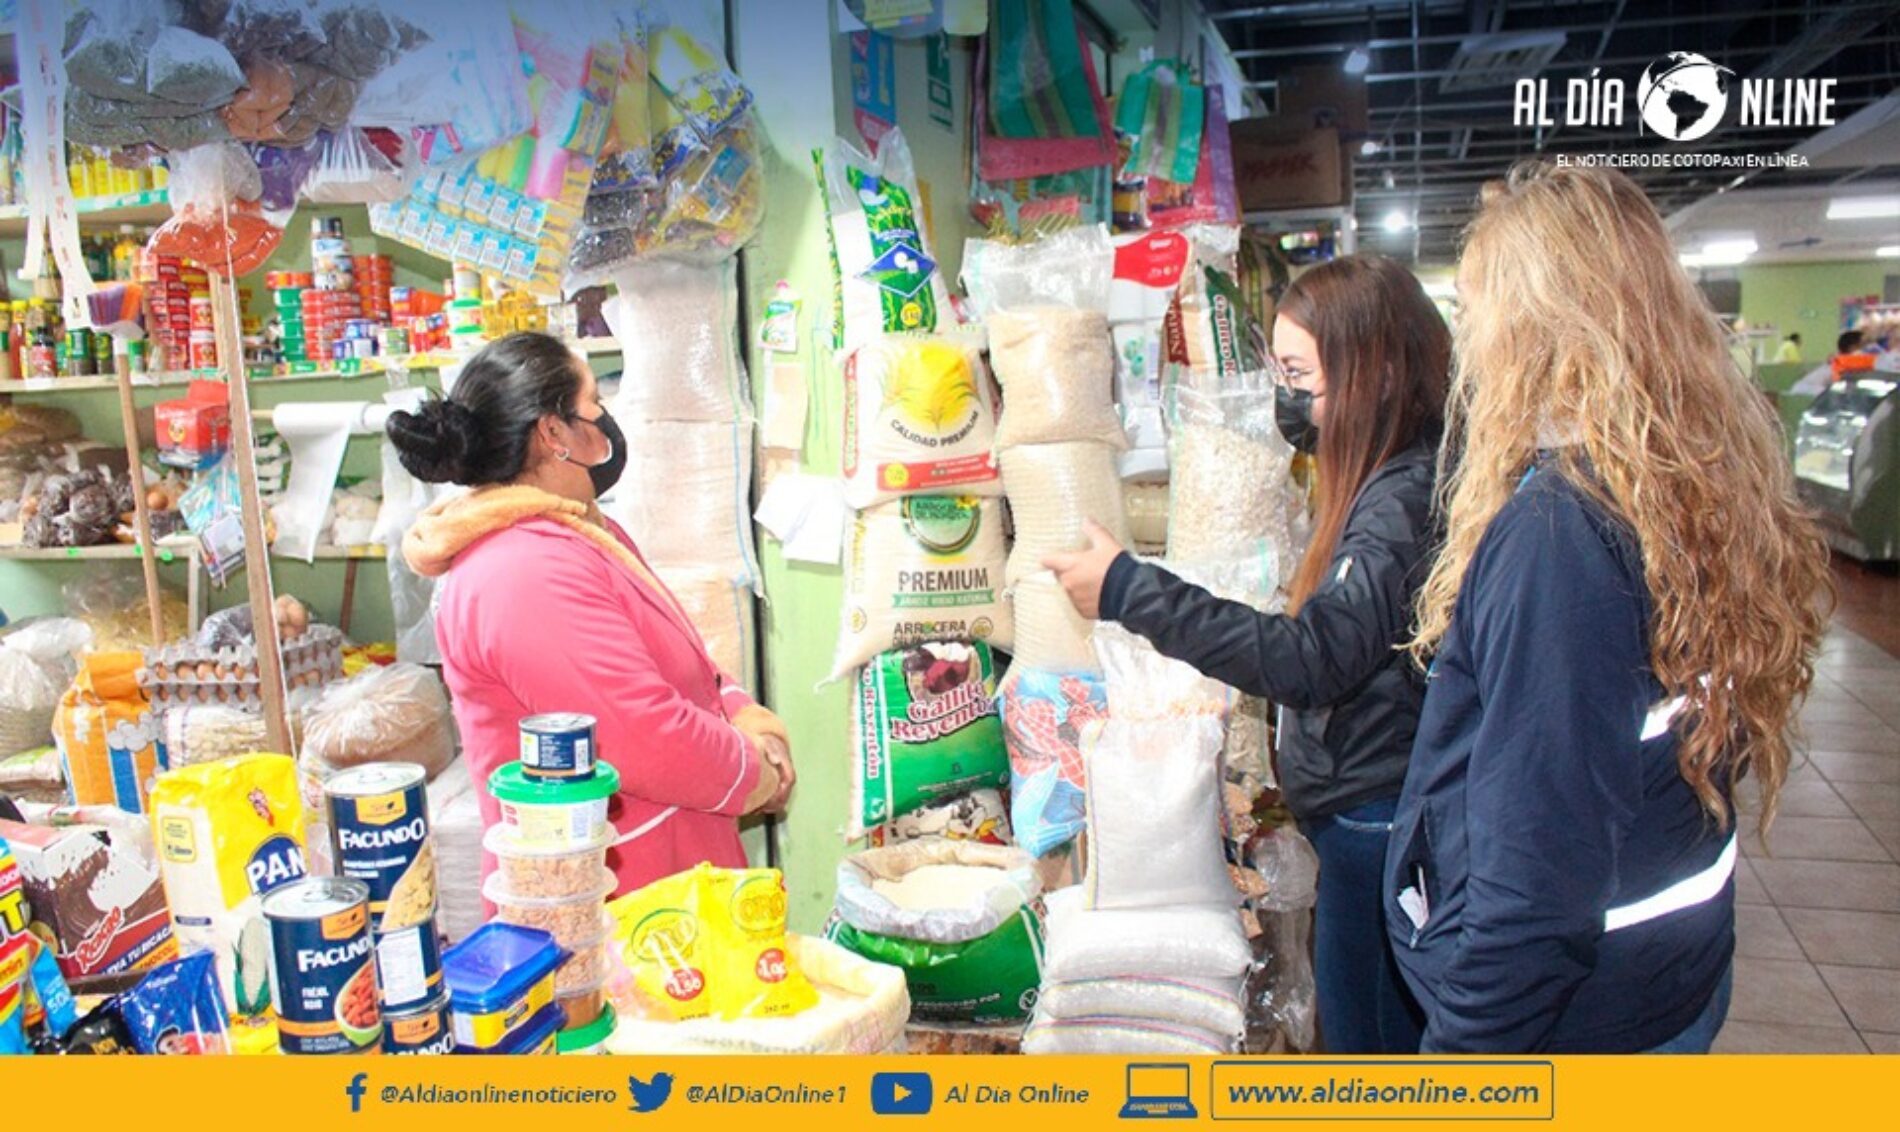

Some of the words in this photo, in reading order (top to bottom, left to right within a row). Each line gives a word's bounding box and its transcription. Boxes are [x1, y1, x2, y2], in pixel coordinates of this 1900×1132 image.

[889, 417, 939, 448] CALIDAD
[939, 409, 980, 447] PREMIUM
[898, 567, 989, 591] PREMIUM
[907, 680, 985, 722] Gallito
[338, 817, 425, 850] FACUNDO
[298, 936, 370, 973] FACUND
